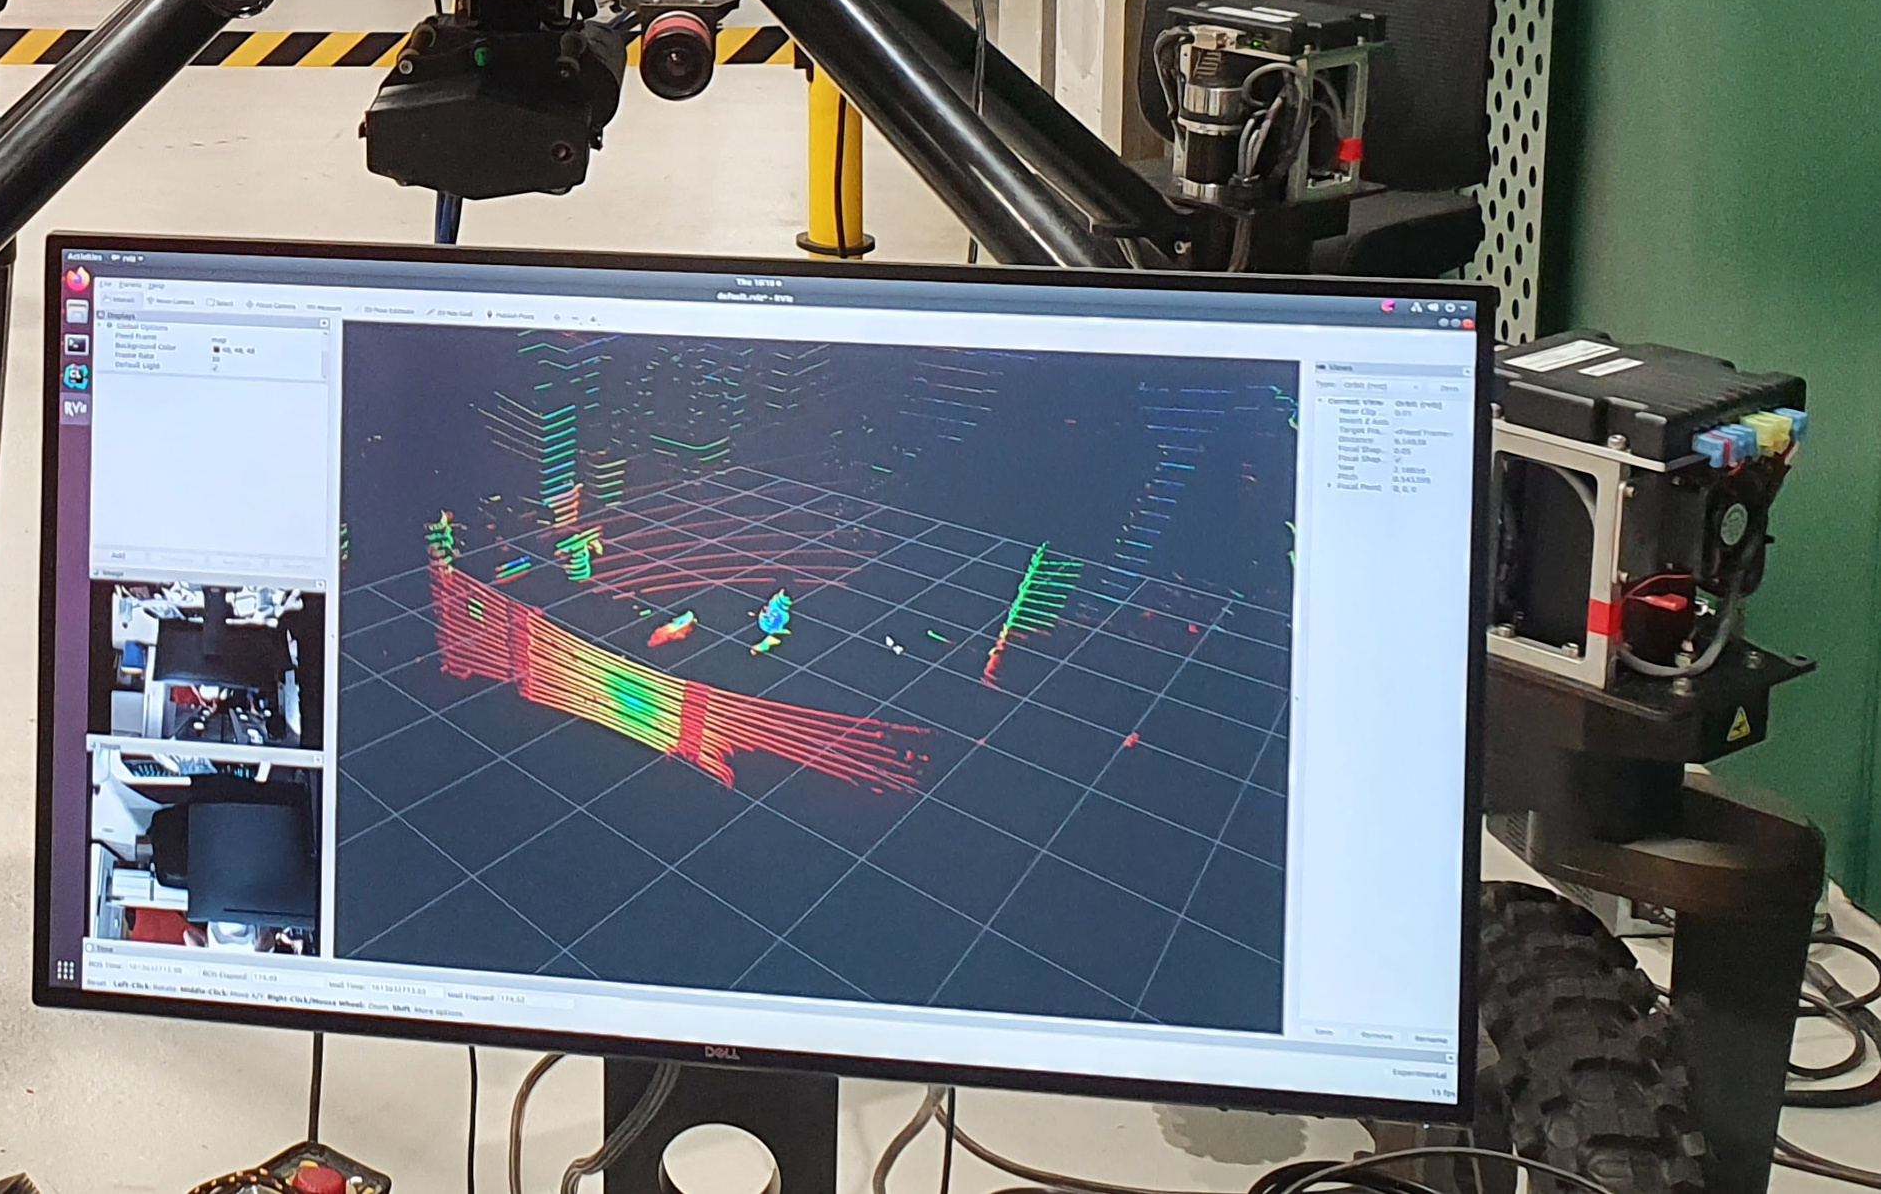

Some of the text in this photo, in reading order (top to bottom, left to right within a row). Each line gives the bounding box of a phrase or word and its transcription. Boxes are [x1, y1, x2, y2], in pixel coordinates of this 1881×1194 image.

[106, 312, 136, 321] Displays
[1328, 364, 1353, 372] Views
[64, 400, 87, 417] RViz
[96, 945, 114, 953] Time
[704, 1045, 741, 1061] DELL
[1392, 1068, 1447, 1080] Experimental
